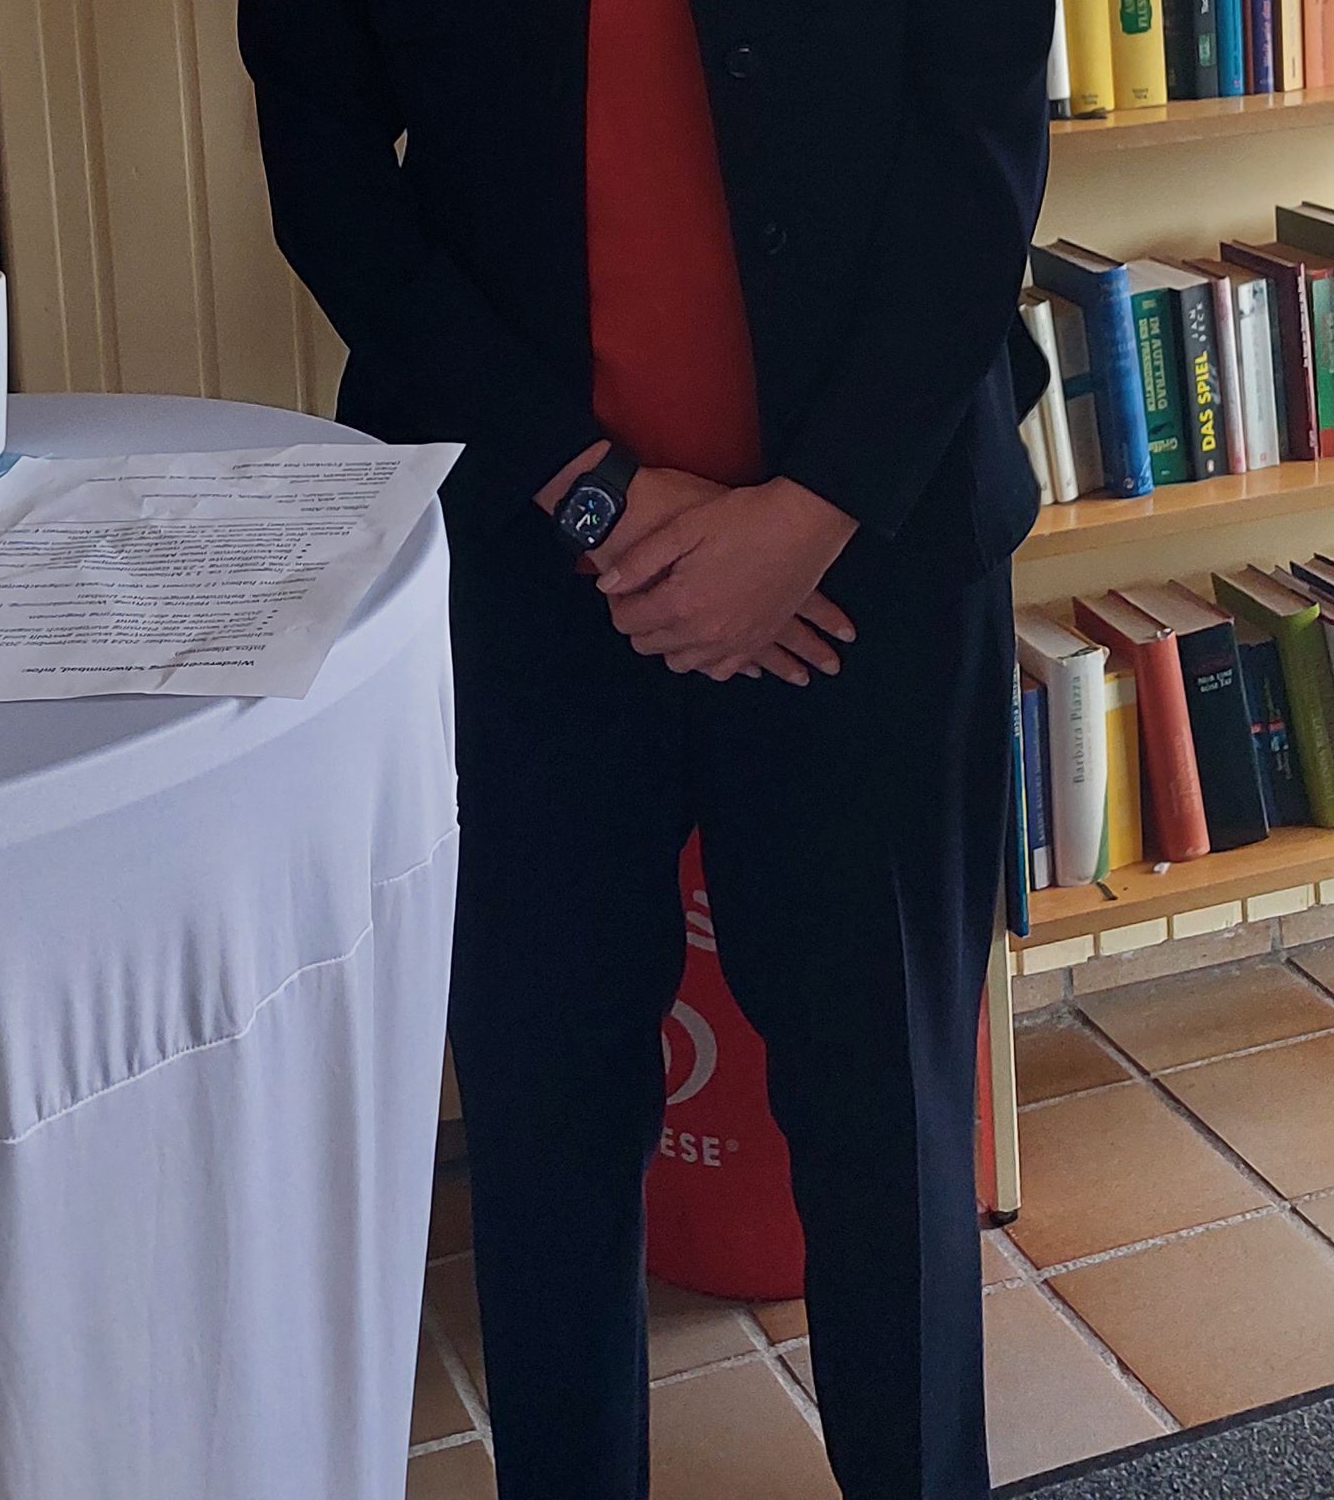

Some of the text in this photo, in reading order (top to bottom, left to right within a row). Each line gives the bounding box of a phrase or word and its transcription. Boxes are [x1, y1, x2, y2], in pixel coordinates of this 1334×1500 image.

[1194, 350, 1217, 452] DAS SPIEL
[1070, 675, 1086, 784] Barbara Piazza
